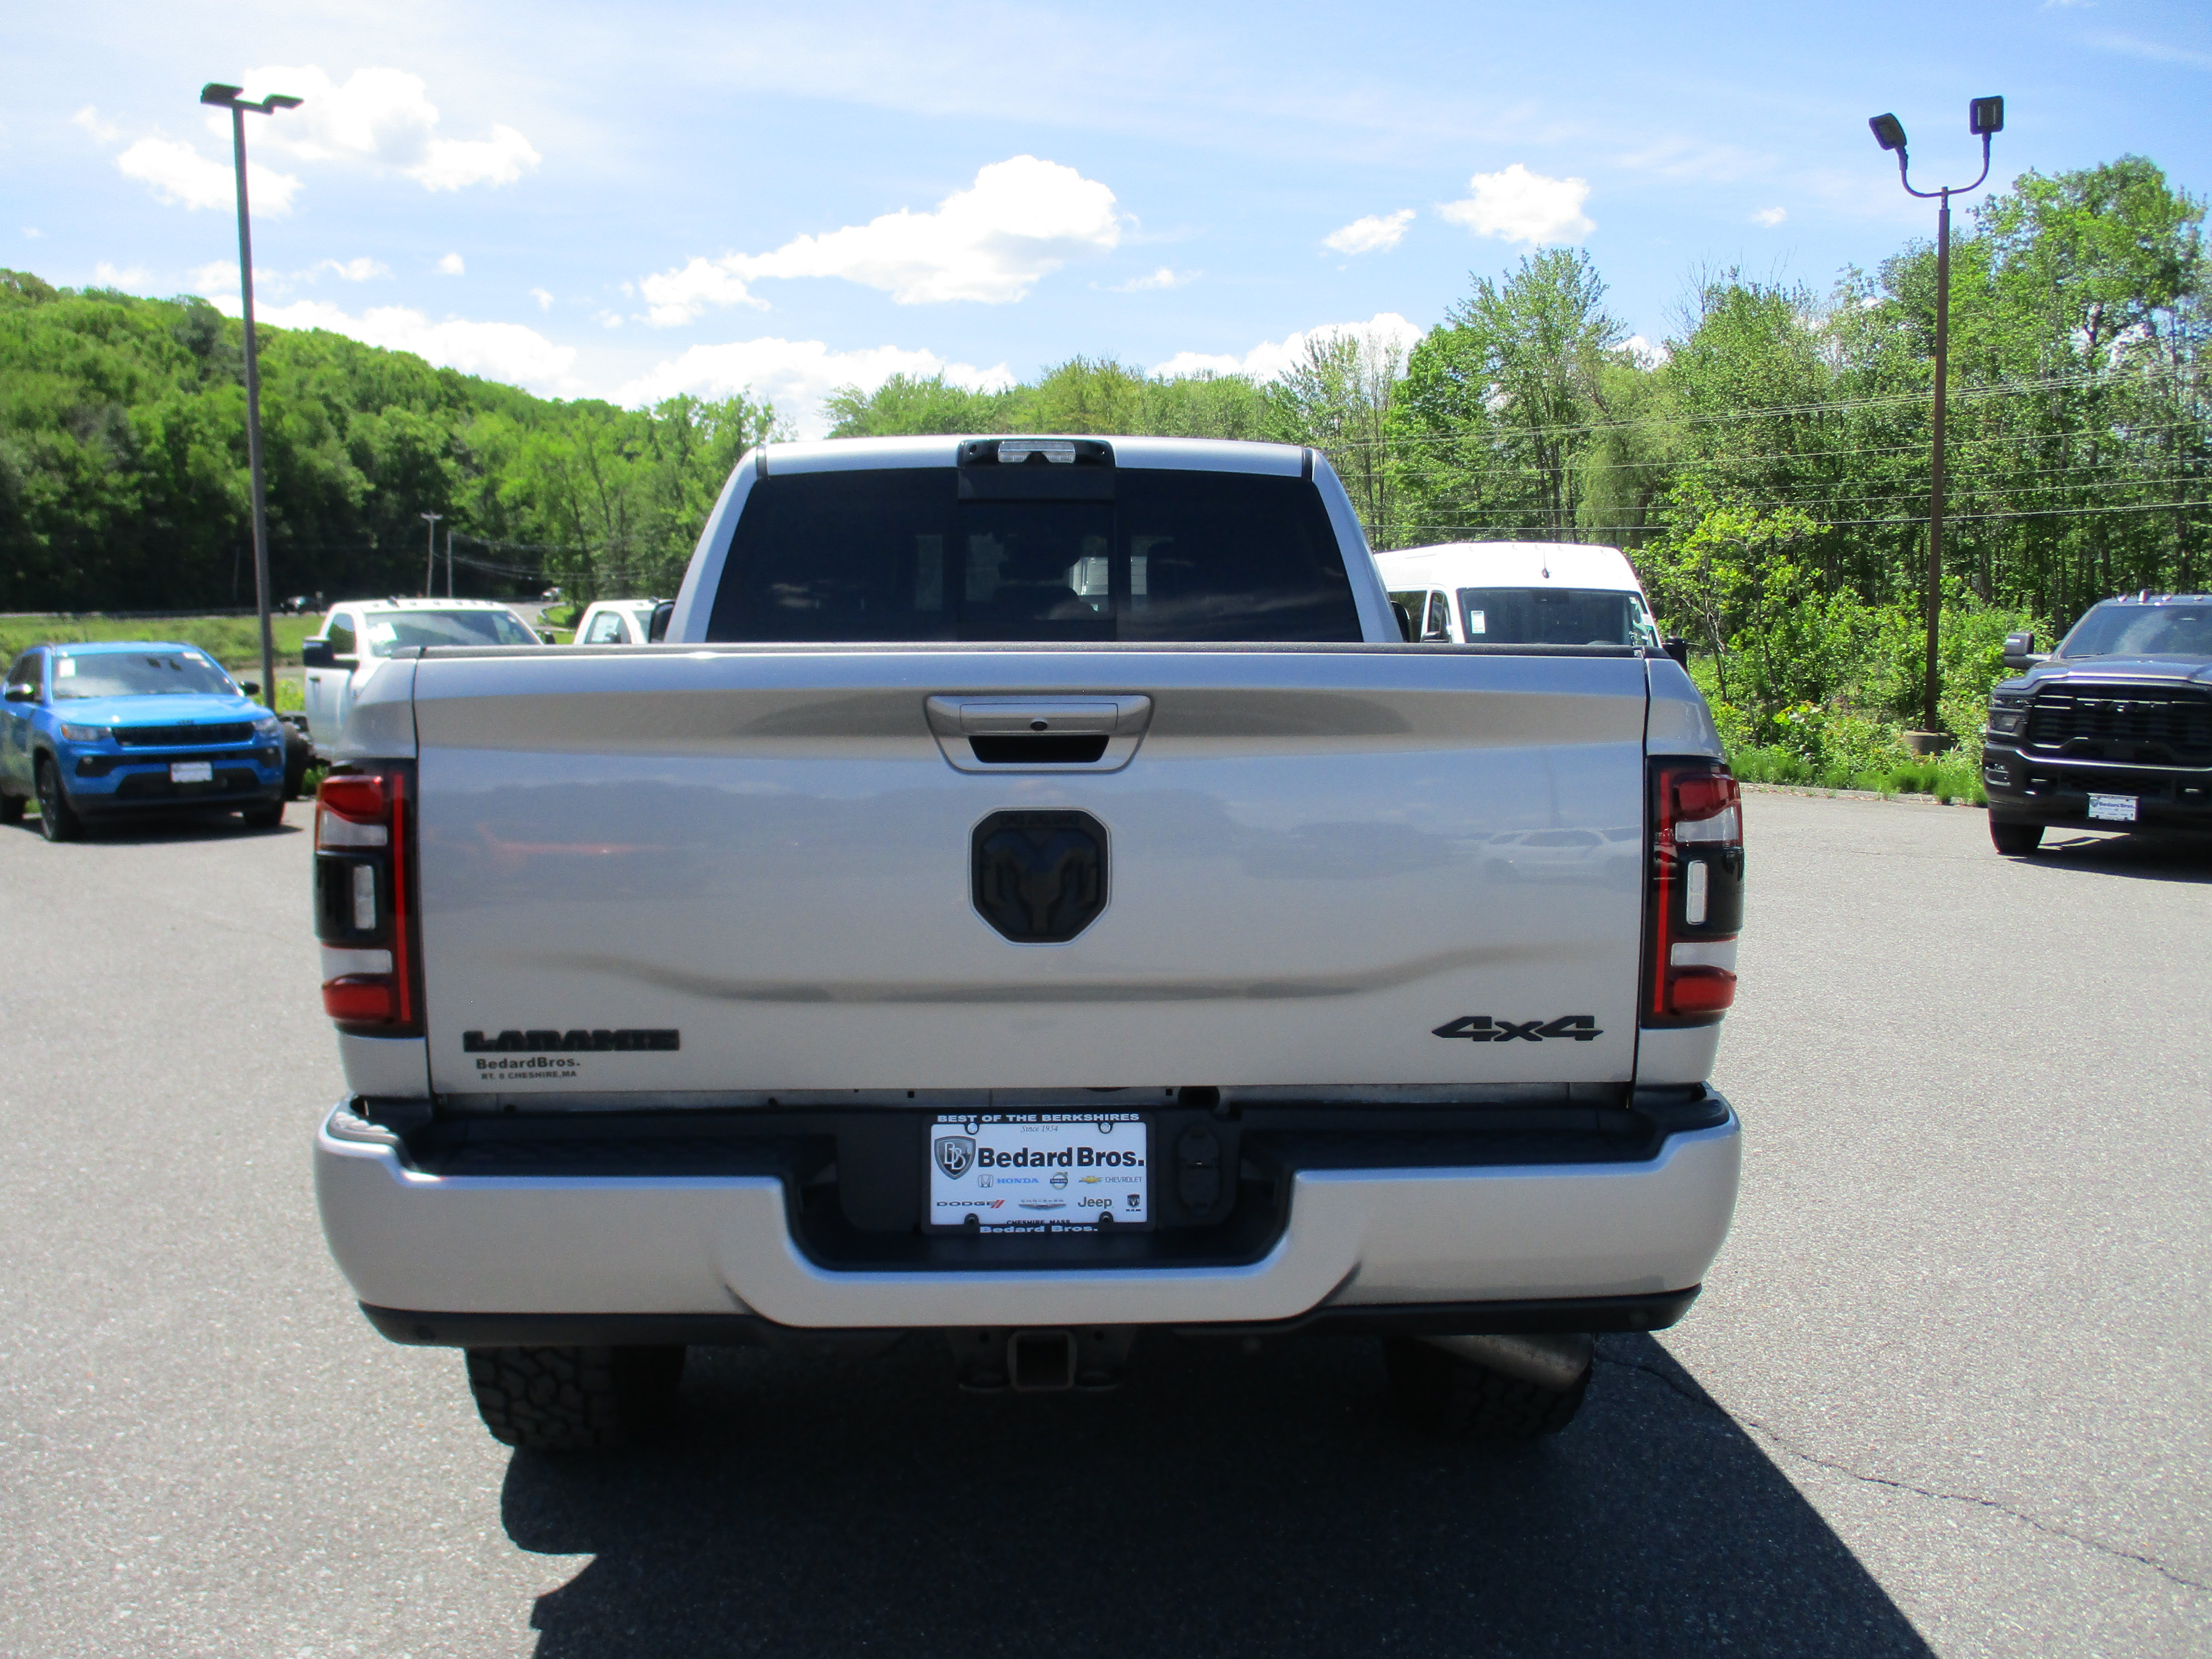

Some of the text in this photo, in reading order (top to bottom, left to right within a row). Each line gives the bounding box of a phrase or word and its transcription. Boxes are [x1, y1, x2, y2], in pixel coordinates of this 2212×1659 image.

[1431, 1015, 1604, 1042] 4x4
[464, 1030, 679, 1052] LARAMIE
[937, 1114, 978, 1122] BEST
[1006, 1114, 1037, 1122] THE
[1041, 1113, 1140, 1121] BERKSHIRES
[1020, 1125, 1039, 1133] Since
[978, 1146, 1145, 1167] Bedard Bros.
[1077, 1196, 1112, 1209] Jeep
[980, 1225, 1045, 1234] Bedard
